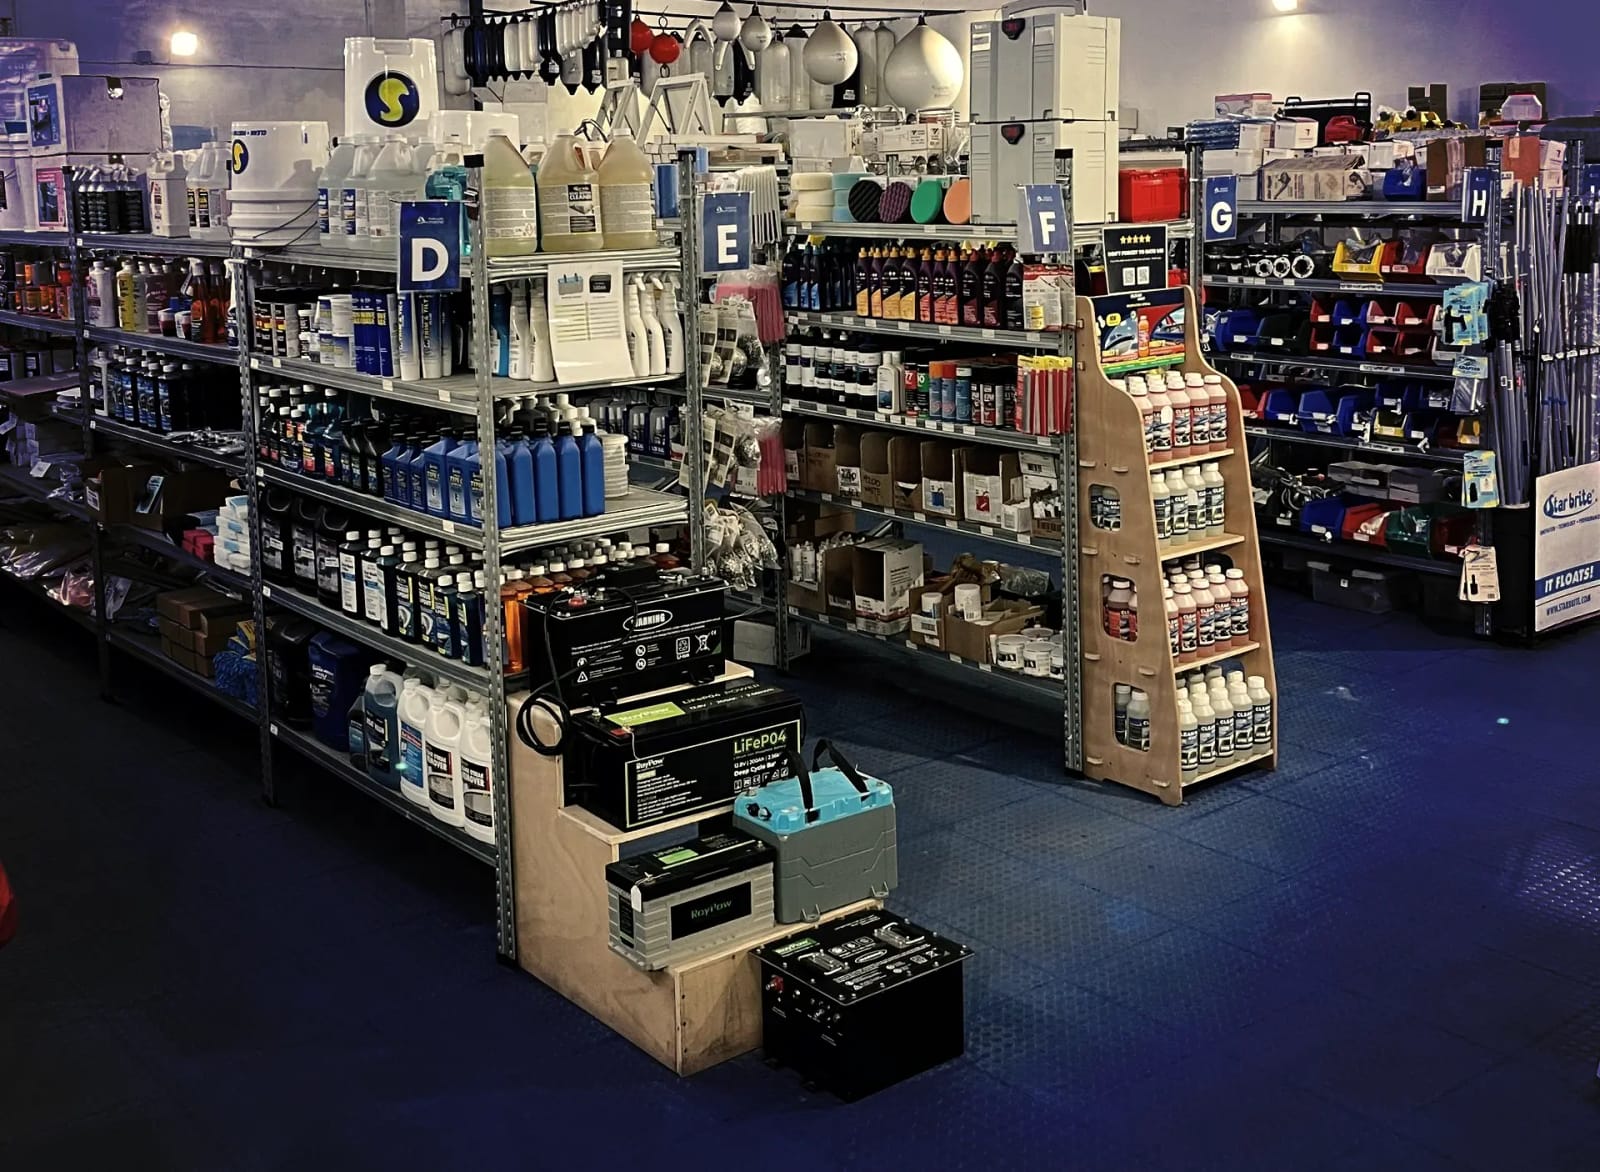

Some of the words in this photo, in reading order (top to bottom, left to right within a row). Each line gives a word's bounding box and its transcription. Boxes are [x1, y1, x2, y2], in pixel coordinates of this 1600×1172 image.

[1211, 201, 1233, 233] G
[1472, 190, 1486, 217] H
[717, 224, 738, 264] E
[1038, 211, 1056, 245] F
[411, 237, 449, 281] D
[1545, 579, 1553, 593] IT
[1555, 565, 1594, 591] FLOATS!
